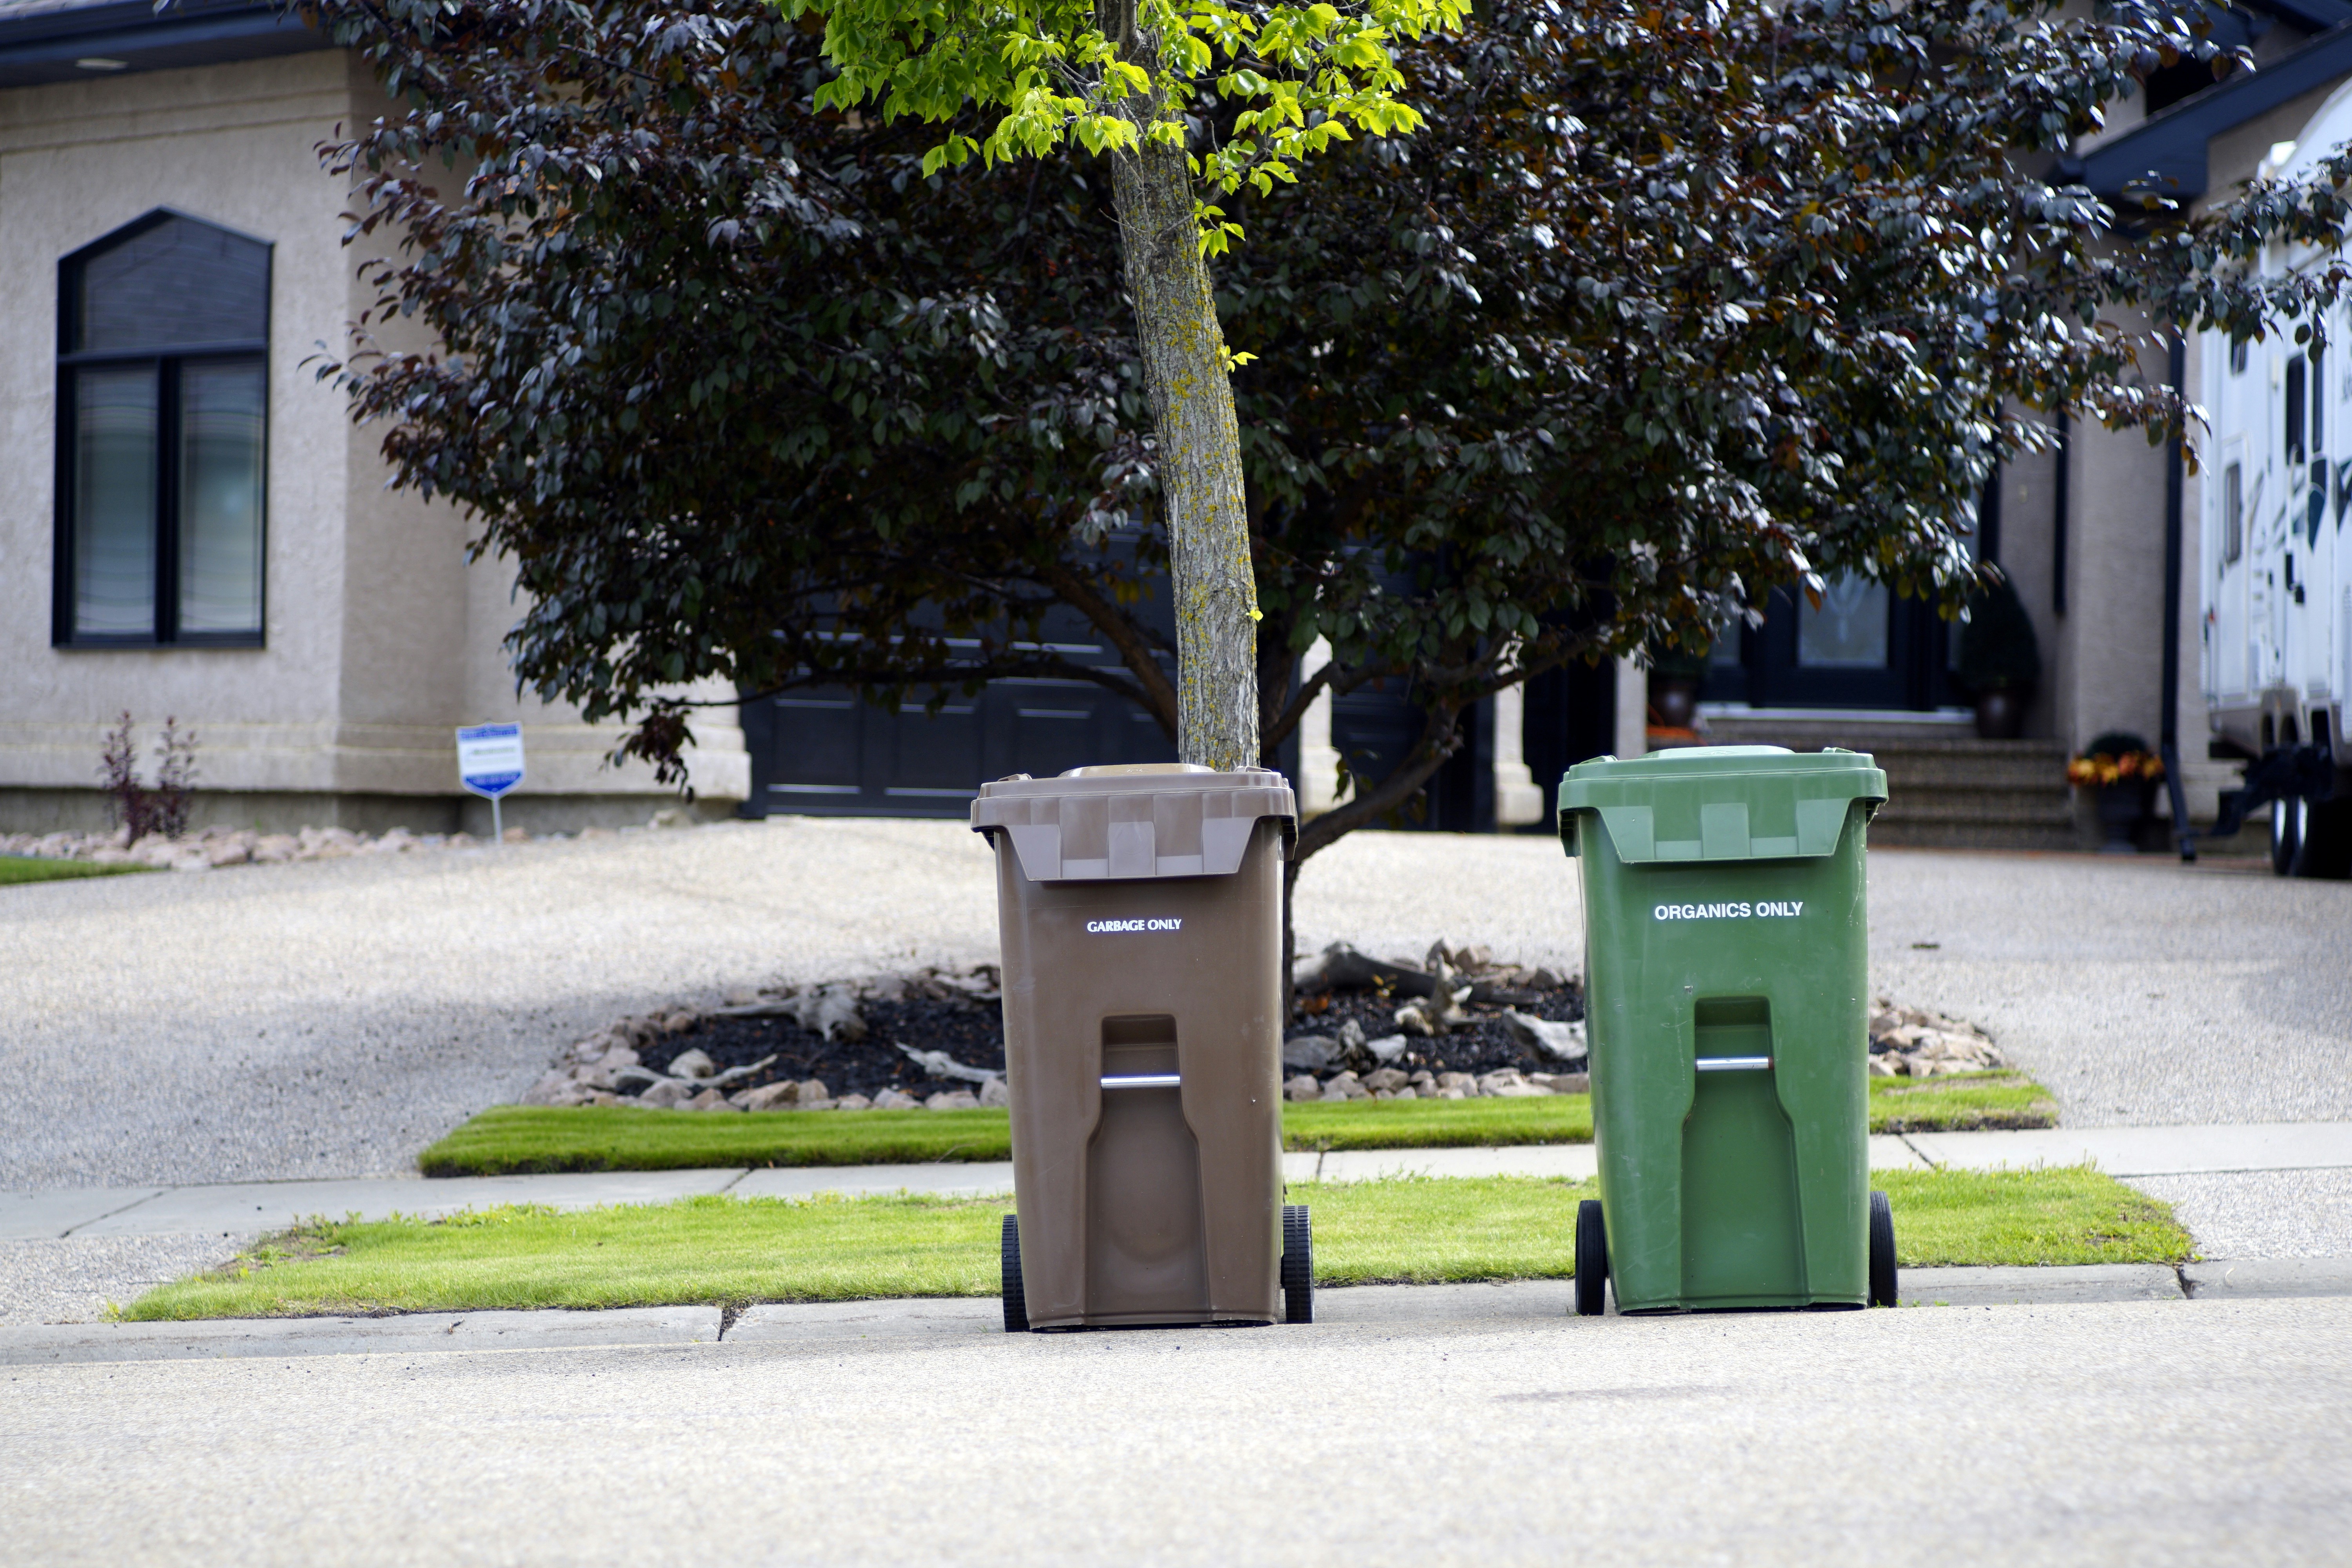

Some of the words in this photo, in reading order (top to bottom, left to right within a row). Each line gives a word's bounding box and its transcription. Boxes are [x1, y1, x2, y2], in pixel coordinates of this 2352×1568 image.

[1655, 903, 1751, 920] ORGANICS
[1756, 902, 1804, 916] ONLY
[1087, 920, 1145, 932] GARBAGE
[1147, 919, 1182, 930] ONLY
